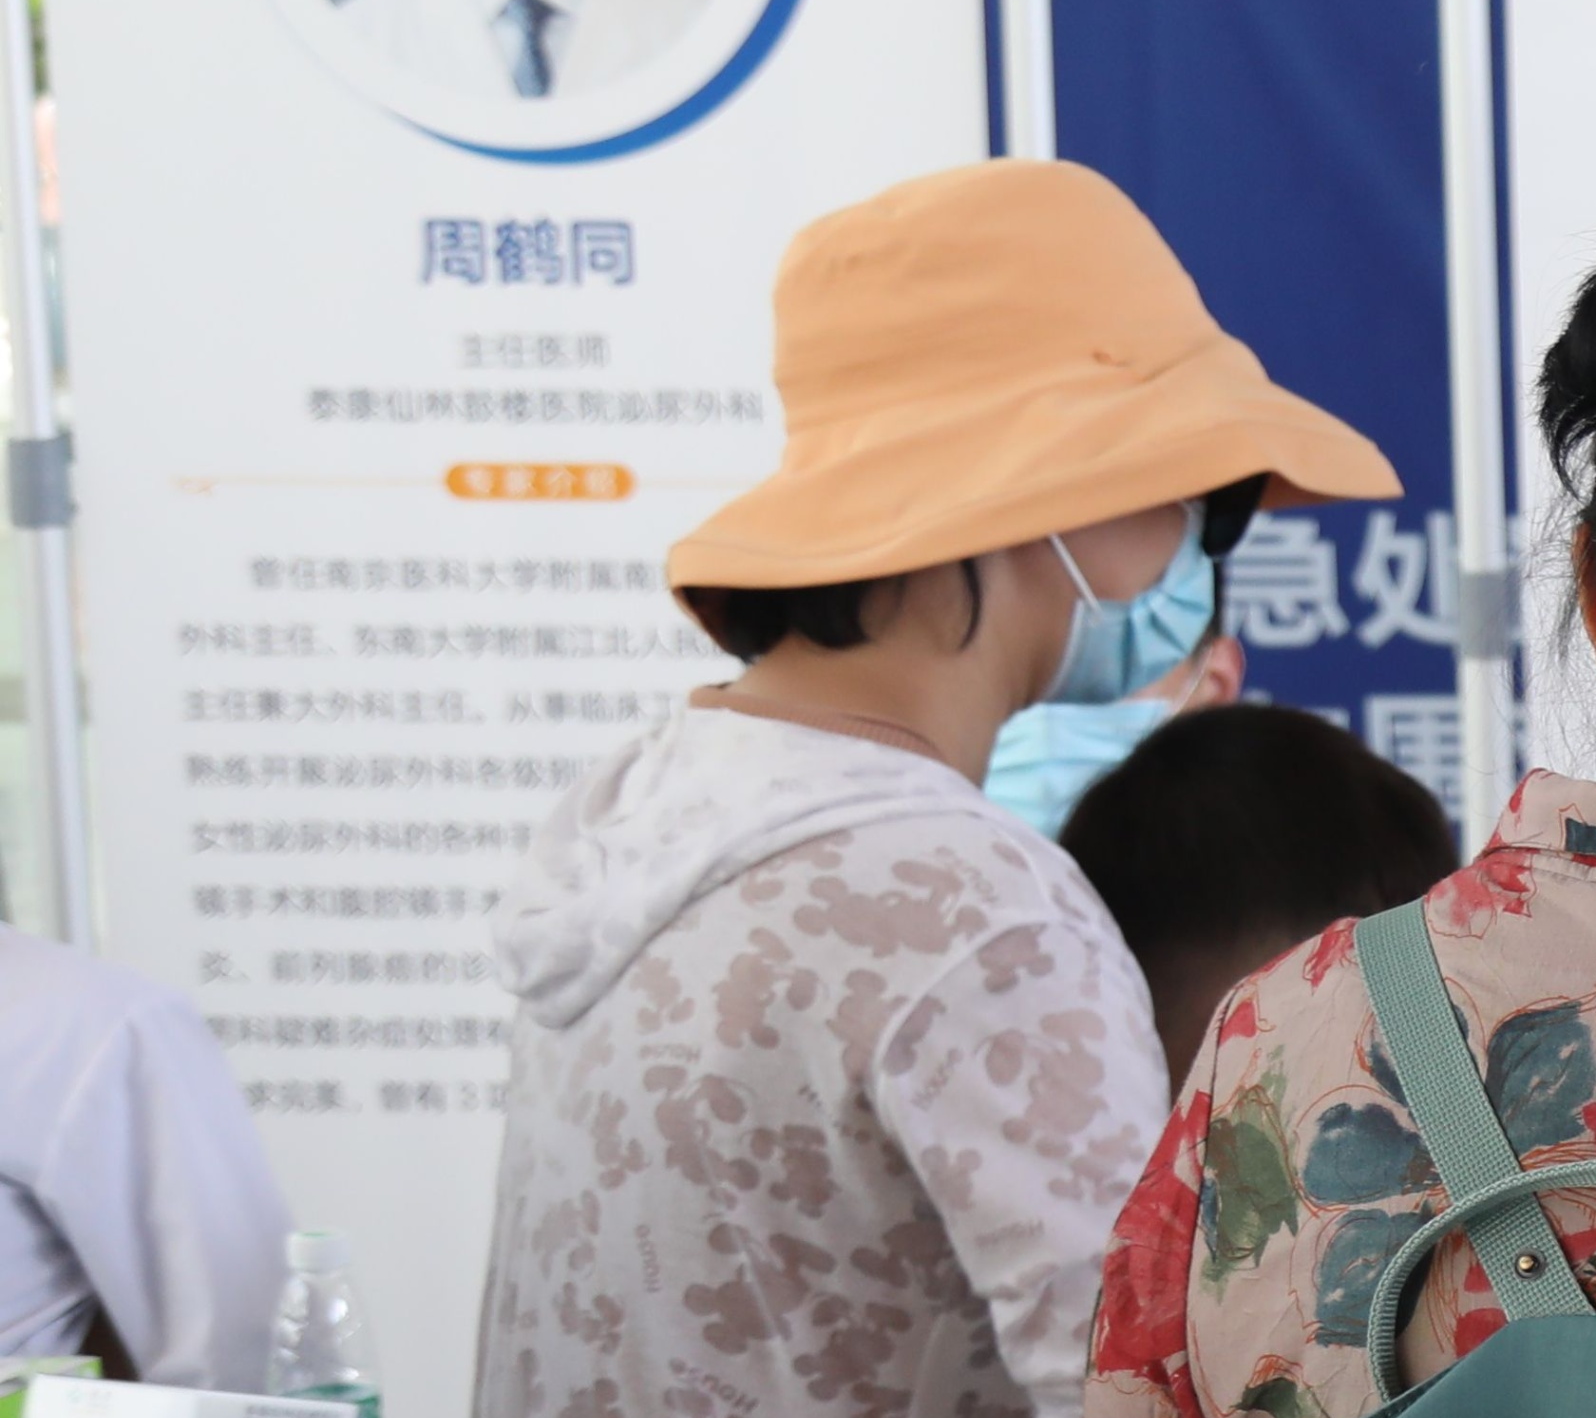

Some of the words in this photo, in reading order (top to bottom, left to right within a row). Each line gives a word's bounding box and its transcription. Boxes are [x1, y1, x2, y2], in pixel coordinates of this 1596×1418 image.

[420, 217, 637, 285] 周鹤同
[251, 557, 668, 592] 曾任南京医科大学附属南
